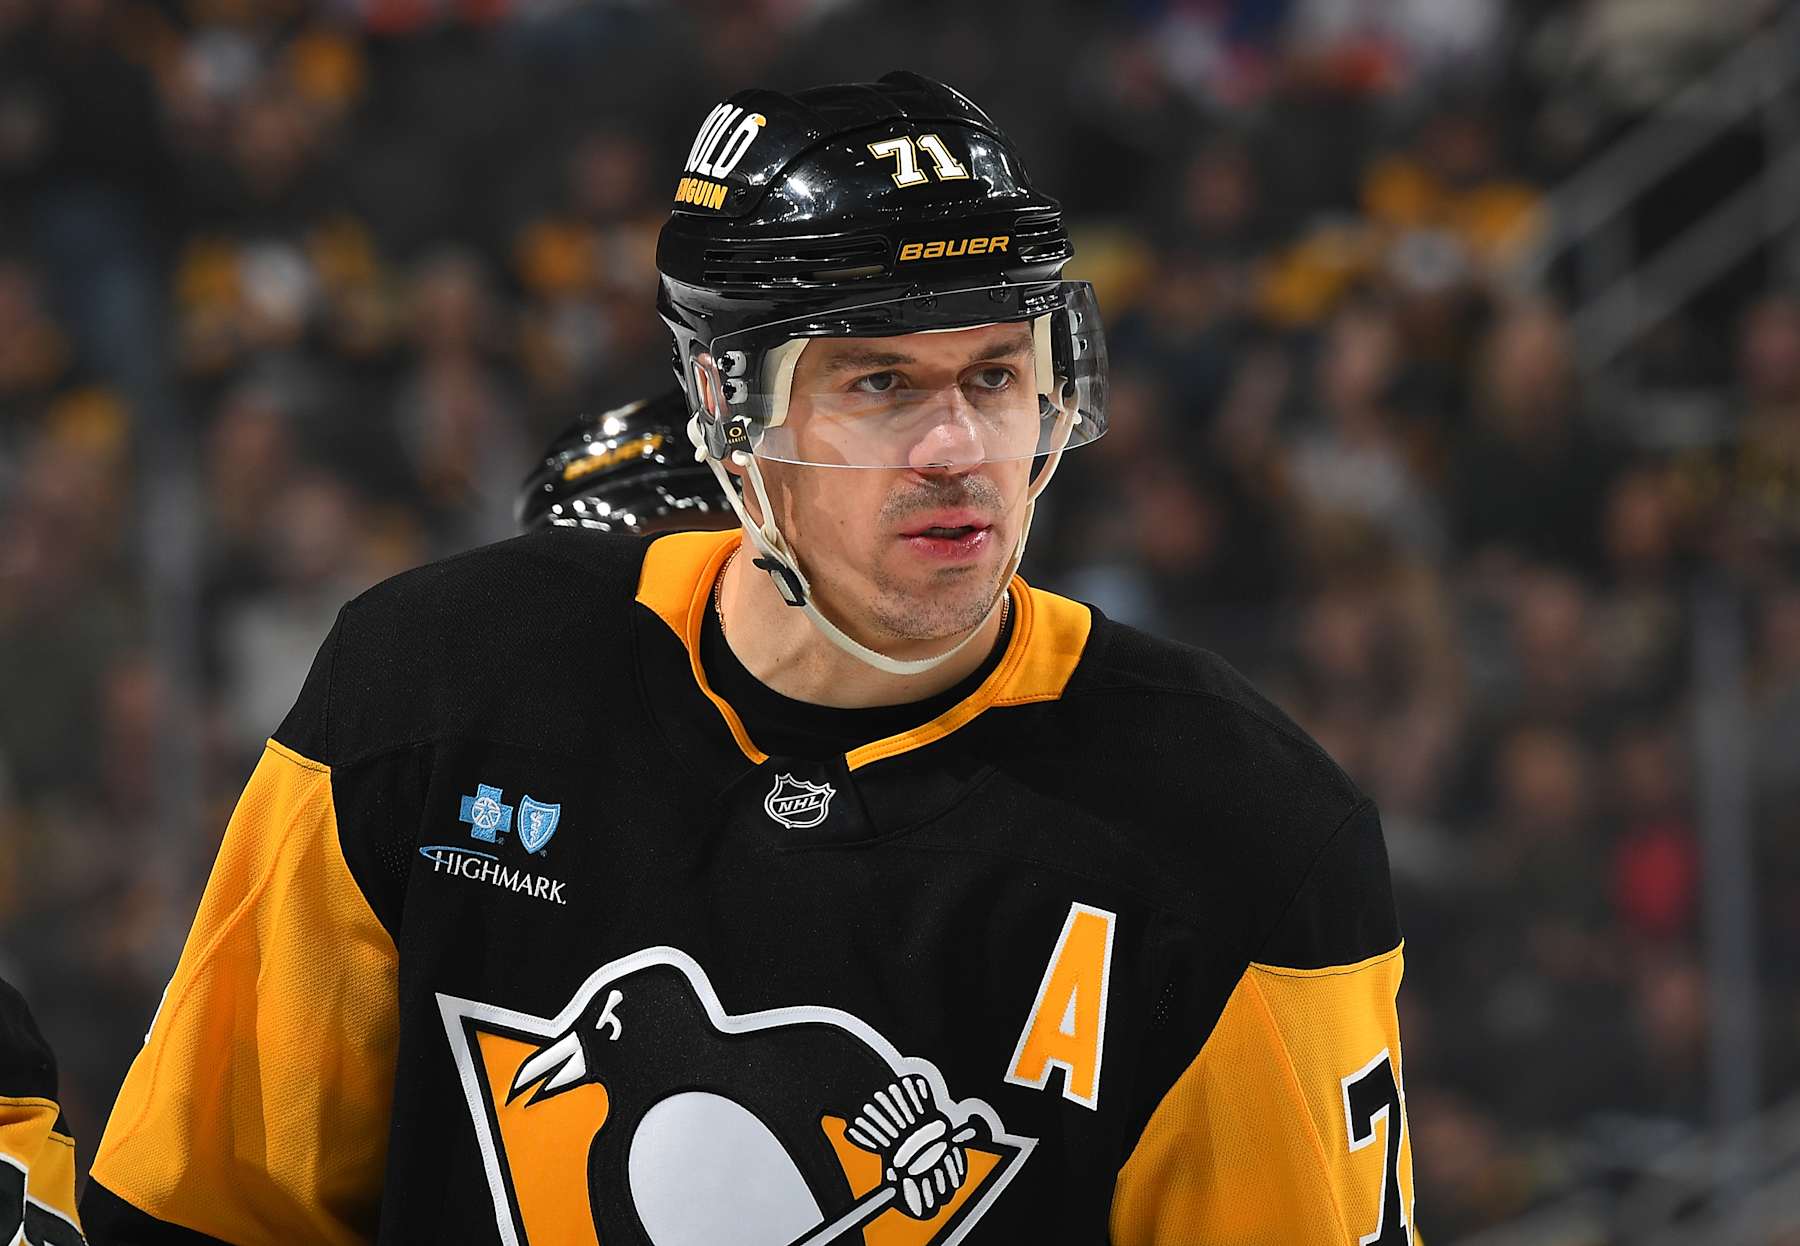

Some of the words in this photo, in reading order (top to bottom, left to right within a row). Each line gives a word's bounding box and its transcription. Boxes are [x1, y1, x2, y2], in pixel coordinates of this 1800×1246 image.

[684, 102, 767, 180] OLD
[867, 134, 970, 189] 71
[778, 795, 820, 813] NHL
[1003, 901, 1117, 1111] A
